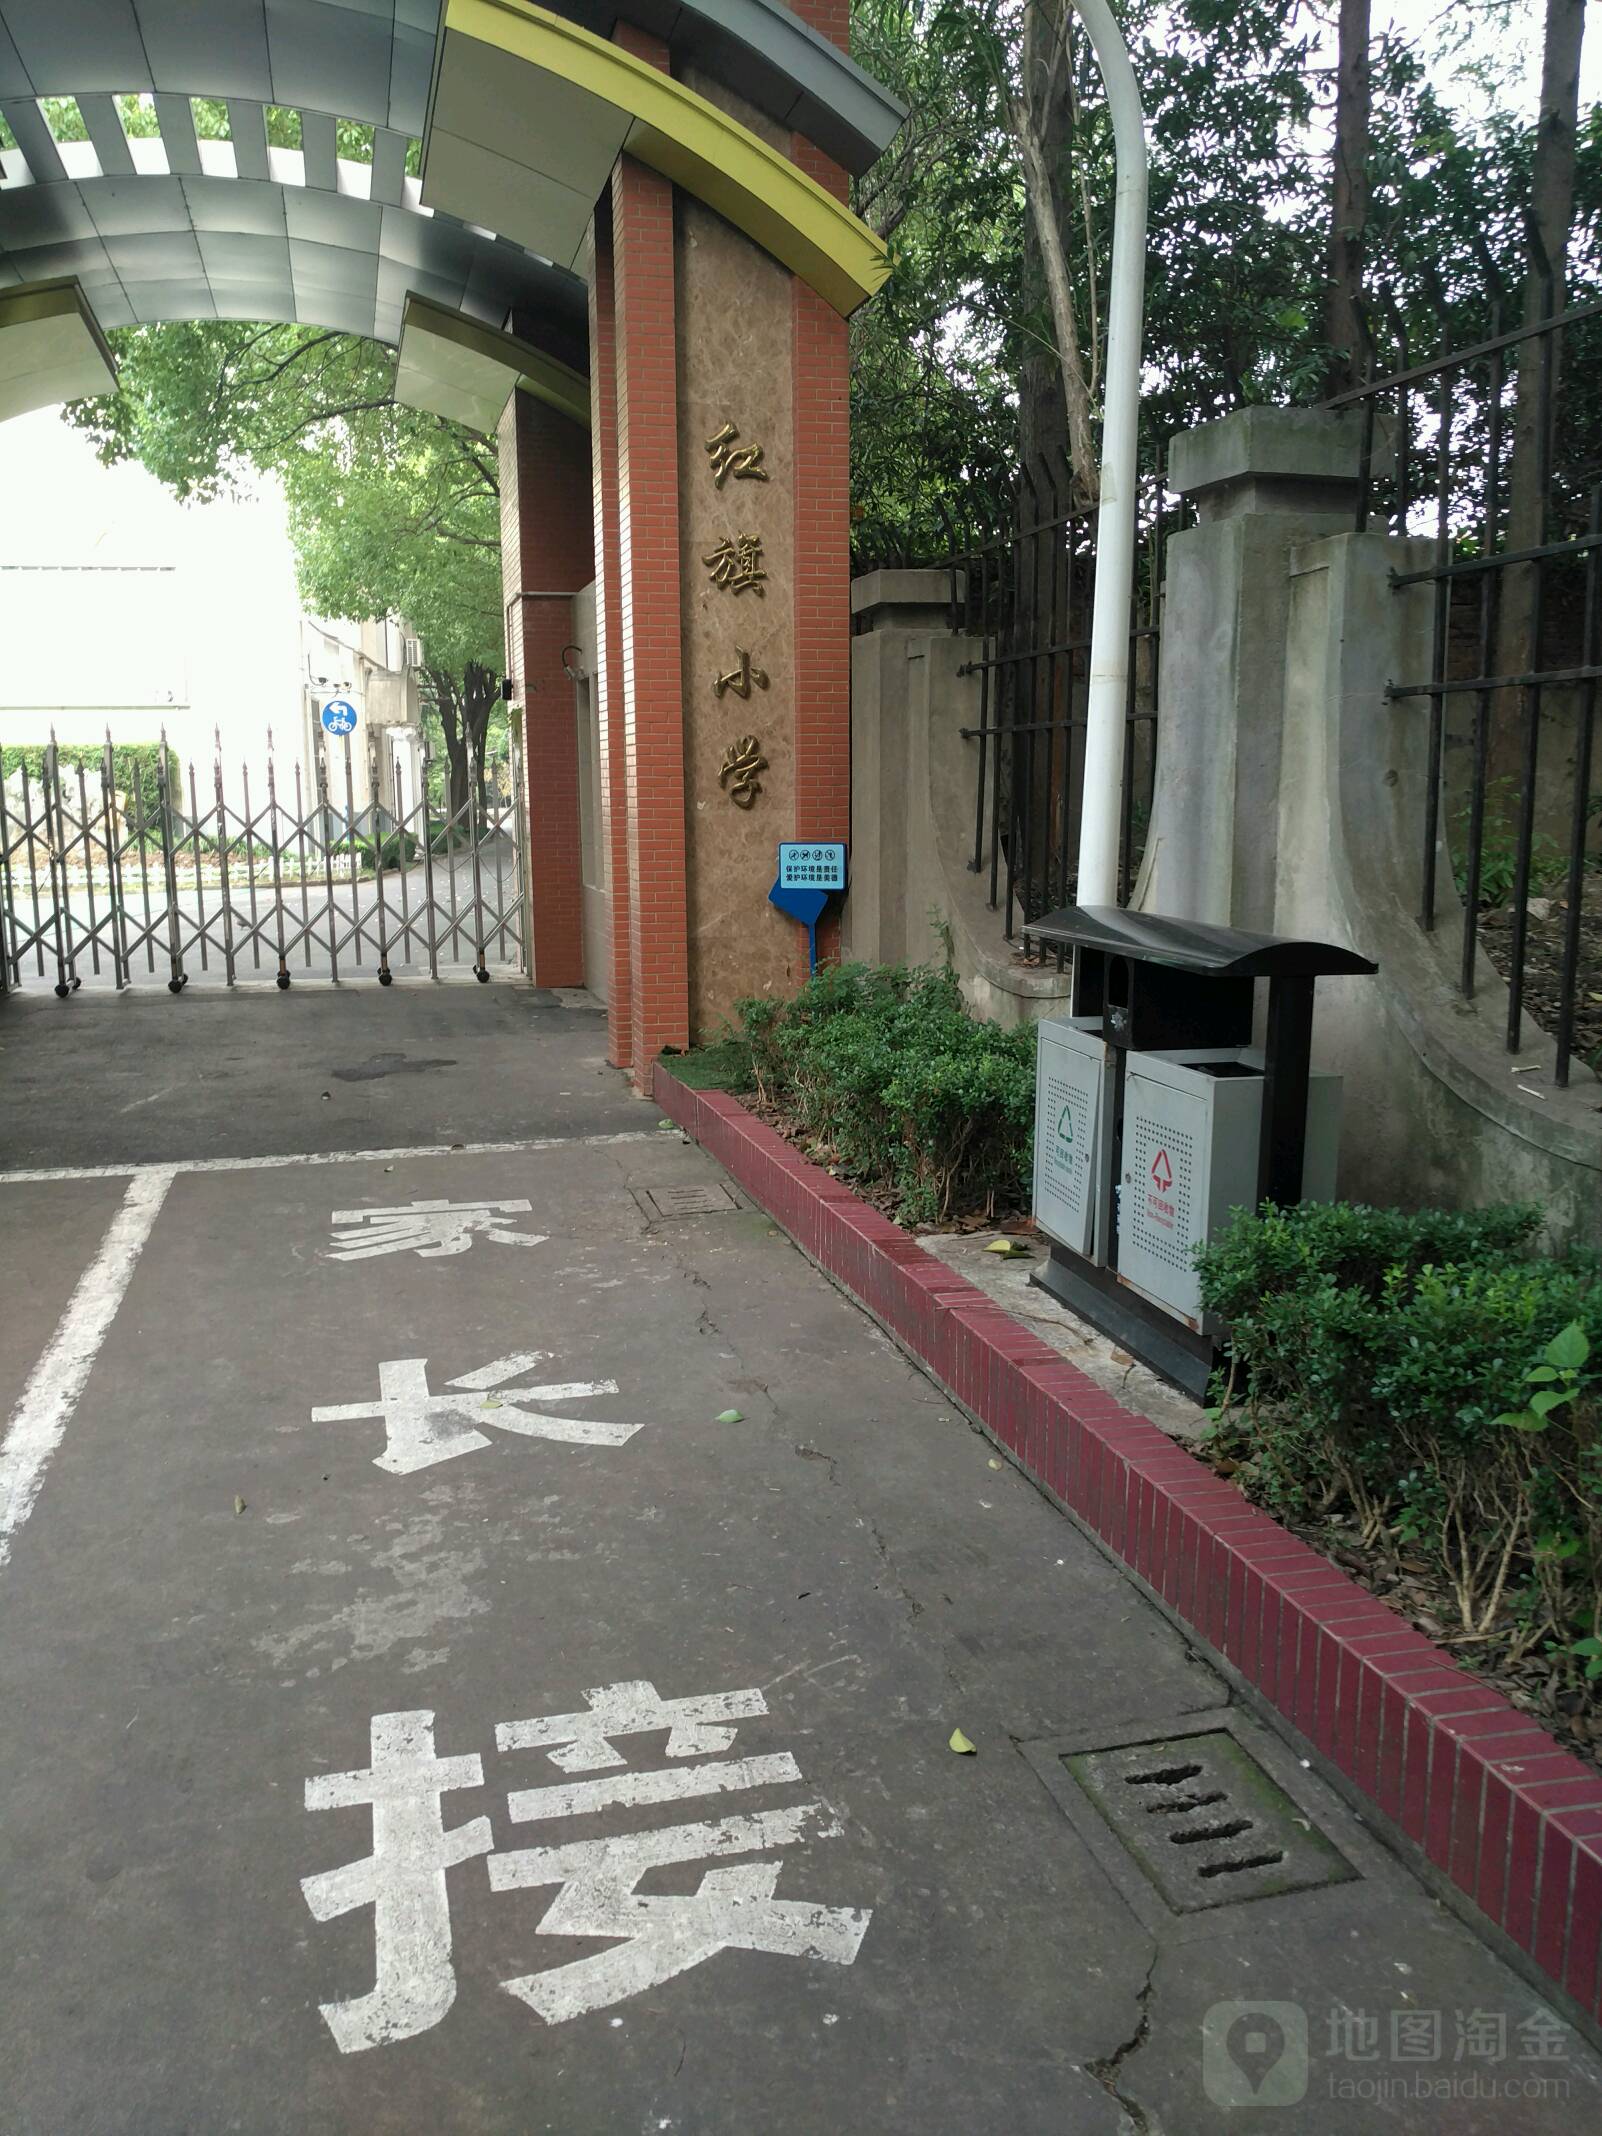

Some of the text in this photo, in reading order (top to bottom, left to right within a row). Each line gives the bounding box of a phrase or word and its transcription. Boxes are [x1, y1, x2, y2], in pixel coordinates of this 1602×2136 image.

[702, 422, 771, 810] 红旗小学
[786, 865, 839, 873] 保护环境是责任
[786, 873, 839, 882] 爱护环境是美德
